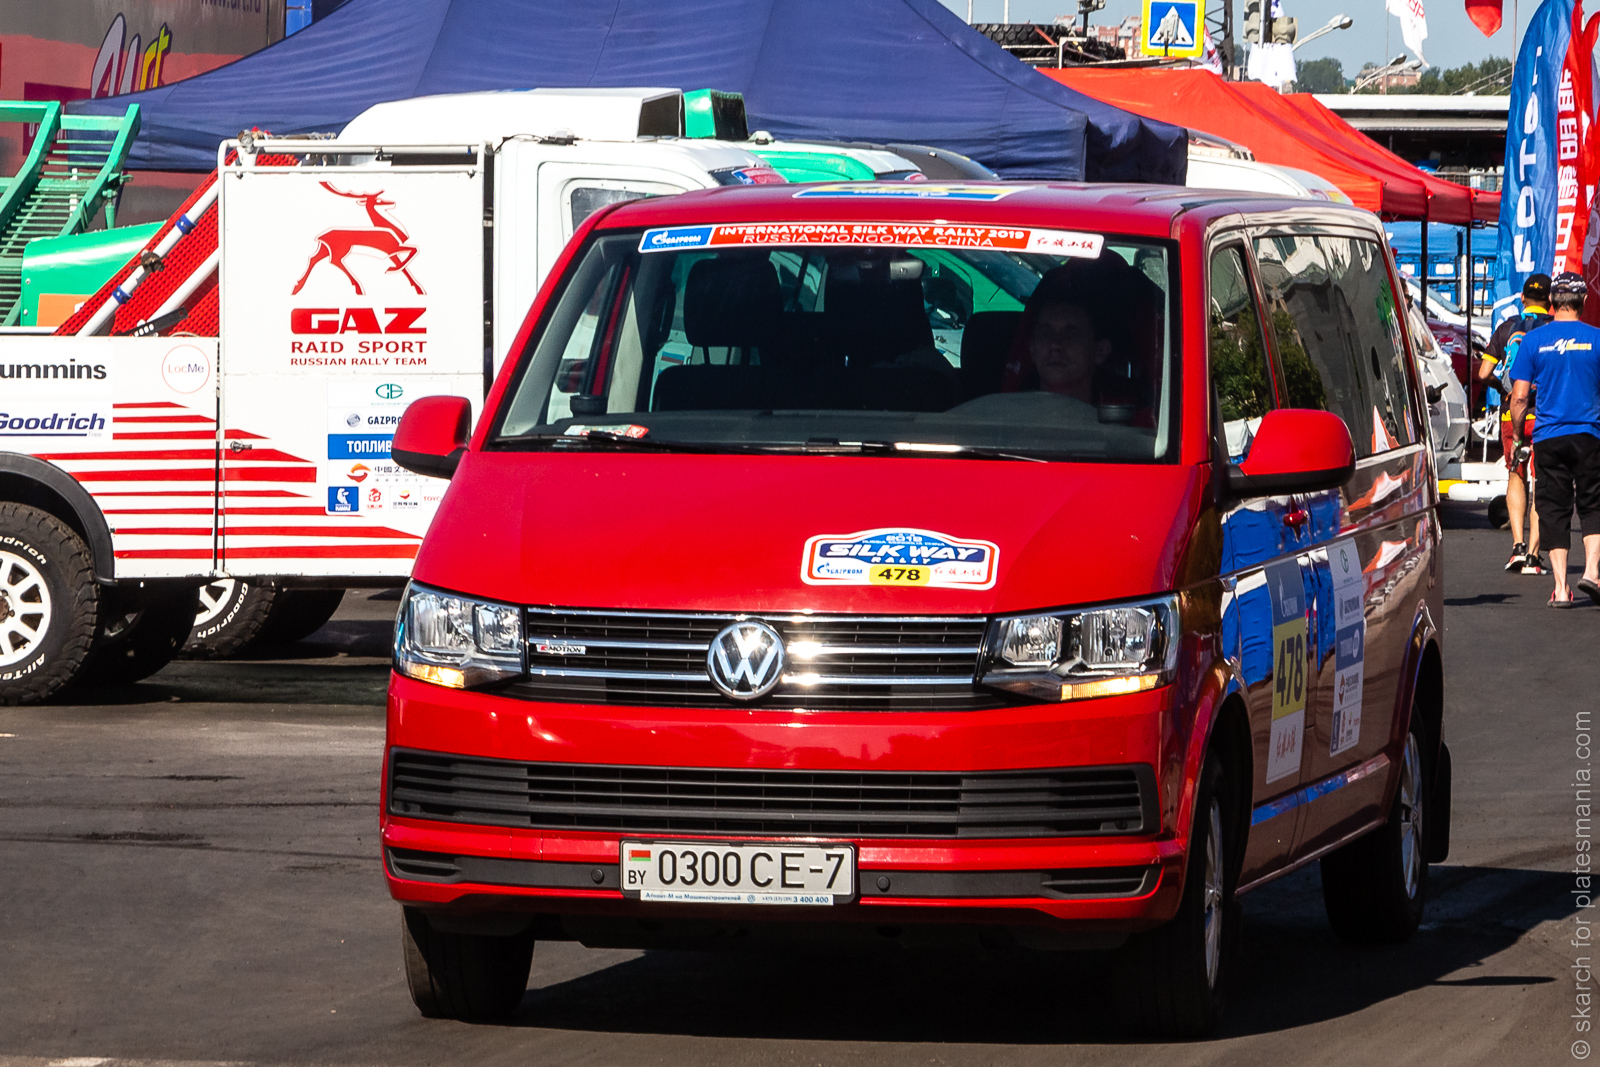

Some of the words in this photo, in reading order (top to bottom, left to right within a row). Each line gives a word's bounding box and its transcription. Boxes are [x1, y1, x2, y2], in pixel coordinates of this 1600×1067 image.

[719, 225, 848, 236] INTERNATIONAL
[852, 225, 888, 235] SILK
[892, 226, 930, 236] WAY
[932, 227, 986, 238] RALLY
[987, 229, 1025, 240] 2019
[290, 306, 427, 335] GAZ
[291, 341, 344, 354] RAID
[358, 340, 427, 354] SPORT
[167, 363, 205, 374] LocMe
[290, 357, 347, 366] RUSSIAN
[351, 357, 390, 366] RALLY
[394, 357, 427, 366] TEAM
[0, 358, 107, 380] ummins
[367, 416, 402, 425] GAZPRO
[346, 440, 393, 454] ТОПЛИВ
[826, 543, 905, 558] SILK
[909, 545, 980, 561] WAY
[870, 556, 931, 565] RALLY
[877, 568, 920, 581] 478
[1276, 633, 1303, 707] 478
[658, 850, 741, 887] 0300
[628, 870, 647, 885] BY
